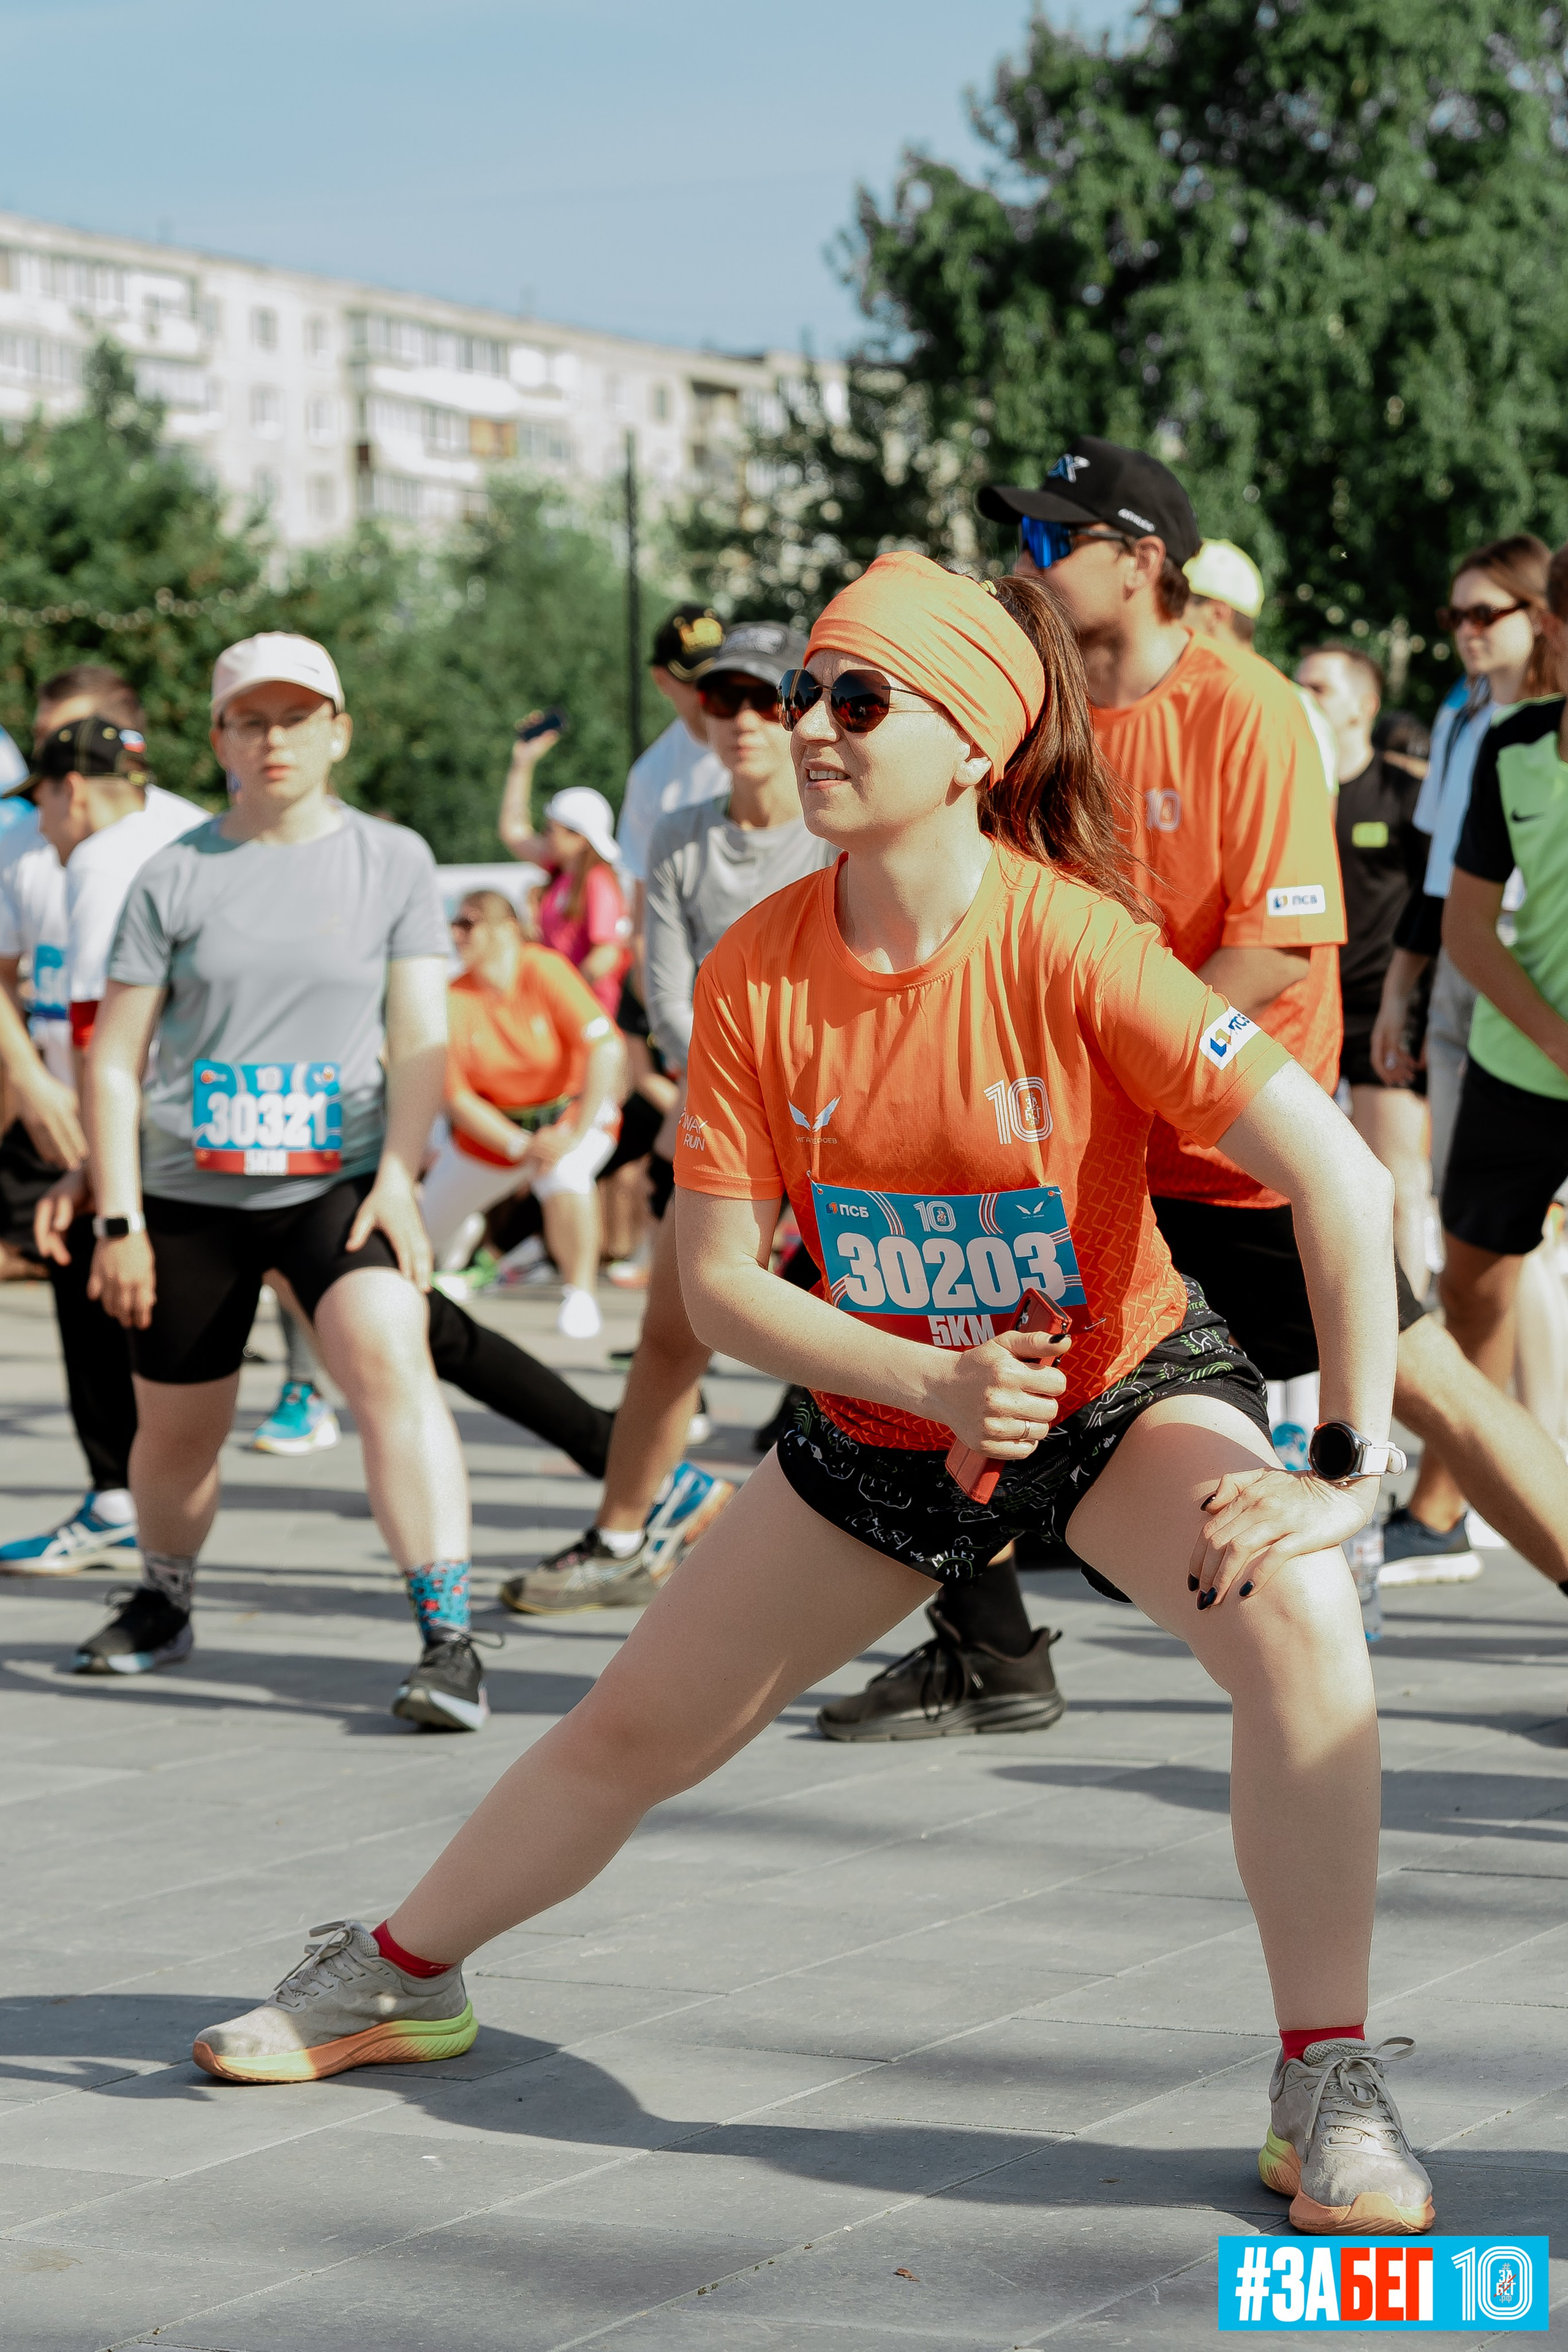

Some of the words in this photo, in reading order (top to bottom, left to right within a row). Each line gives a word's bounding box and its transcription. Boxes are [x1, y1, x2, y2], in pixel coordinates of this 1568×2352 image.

[1145, 788, 1182, 831] 10
[207, 1091, 327, 1147] 30321
[983, 1076, 1053, 1145] 10
[682, 1133, 705, 1152] RUN
[839, 1204, 869, 1218] ПСБ
[913, 1201, 957, 1232] 10
[837, 1232, 1066, 1308] 30203
[927, 1314, 996, 1346] 5KM
